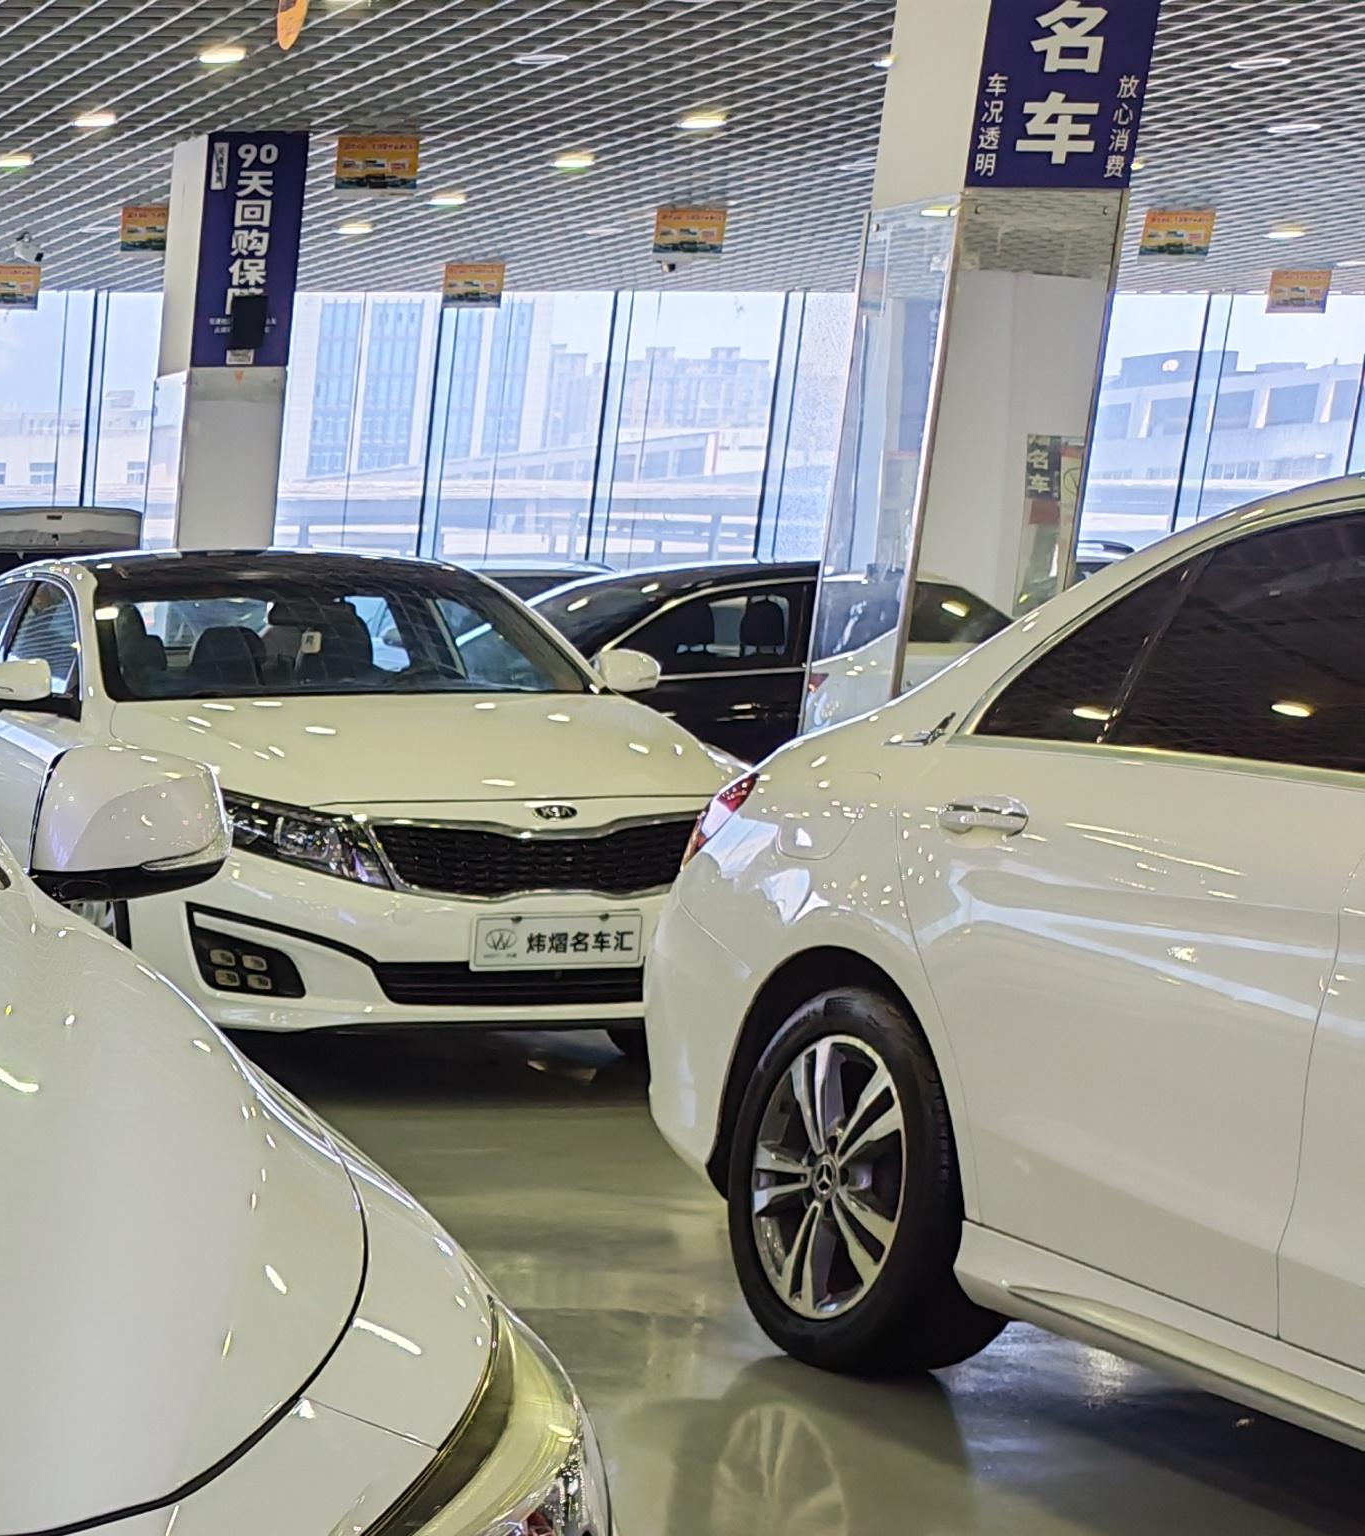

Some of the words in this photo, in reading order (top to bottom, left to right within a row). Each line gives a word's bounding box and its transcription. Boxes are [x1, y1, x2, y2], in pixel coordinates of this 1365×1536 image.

[974, 73, 1009, 177] 车况透明
[1015, 0, 1110, 165] 名车
[1103, 75, 1141, 178] 放心消费
[526, 931, 634, 954] 炜熠名车汇
